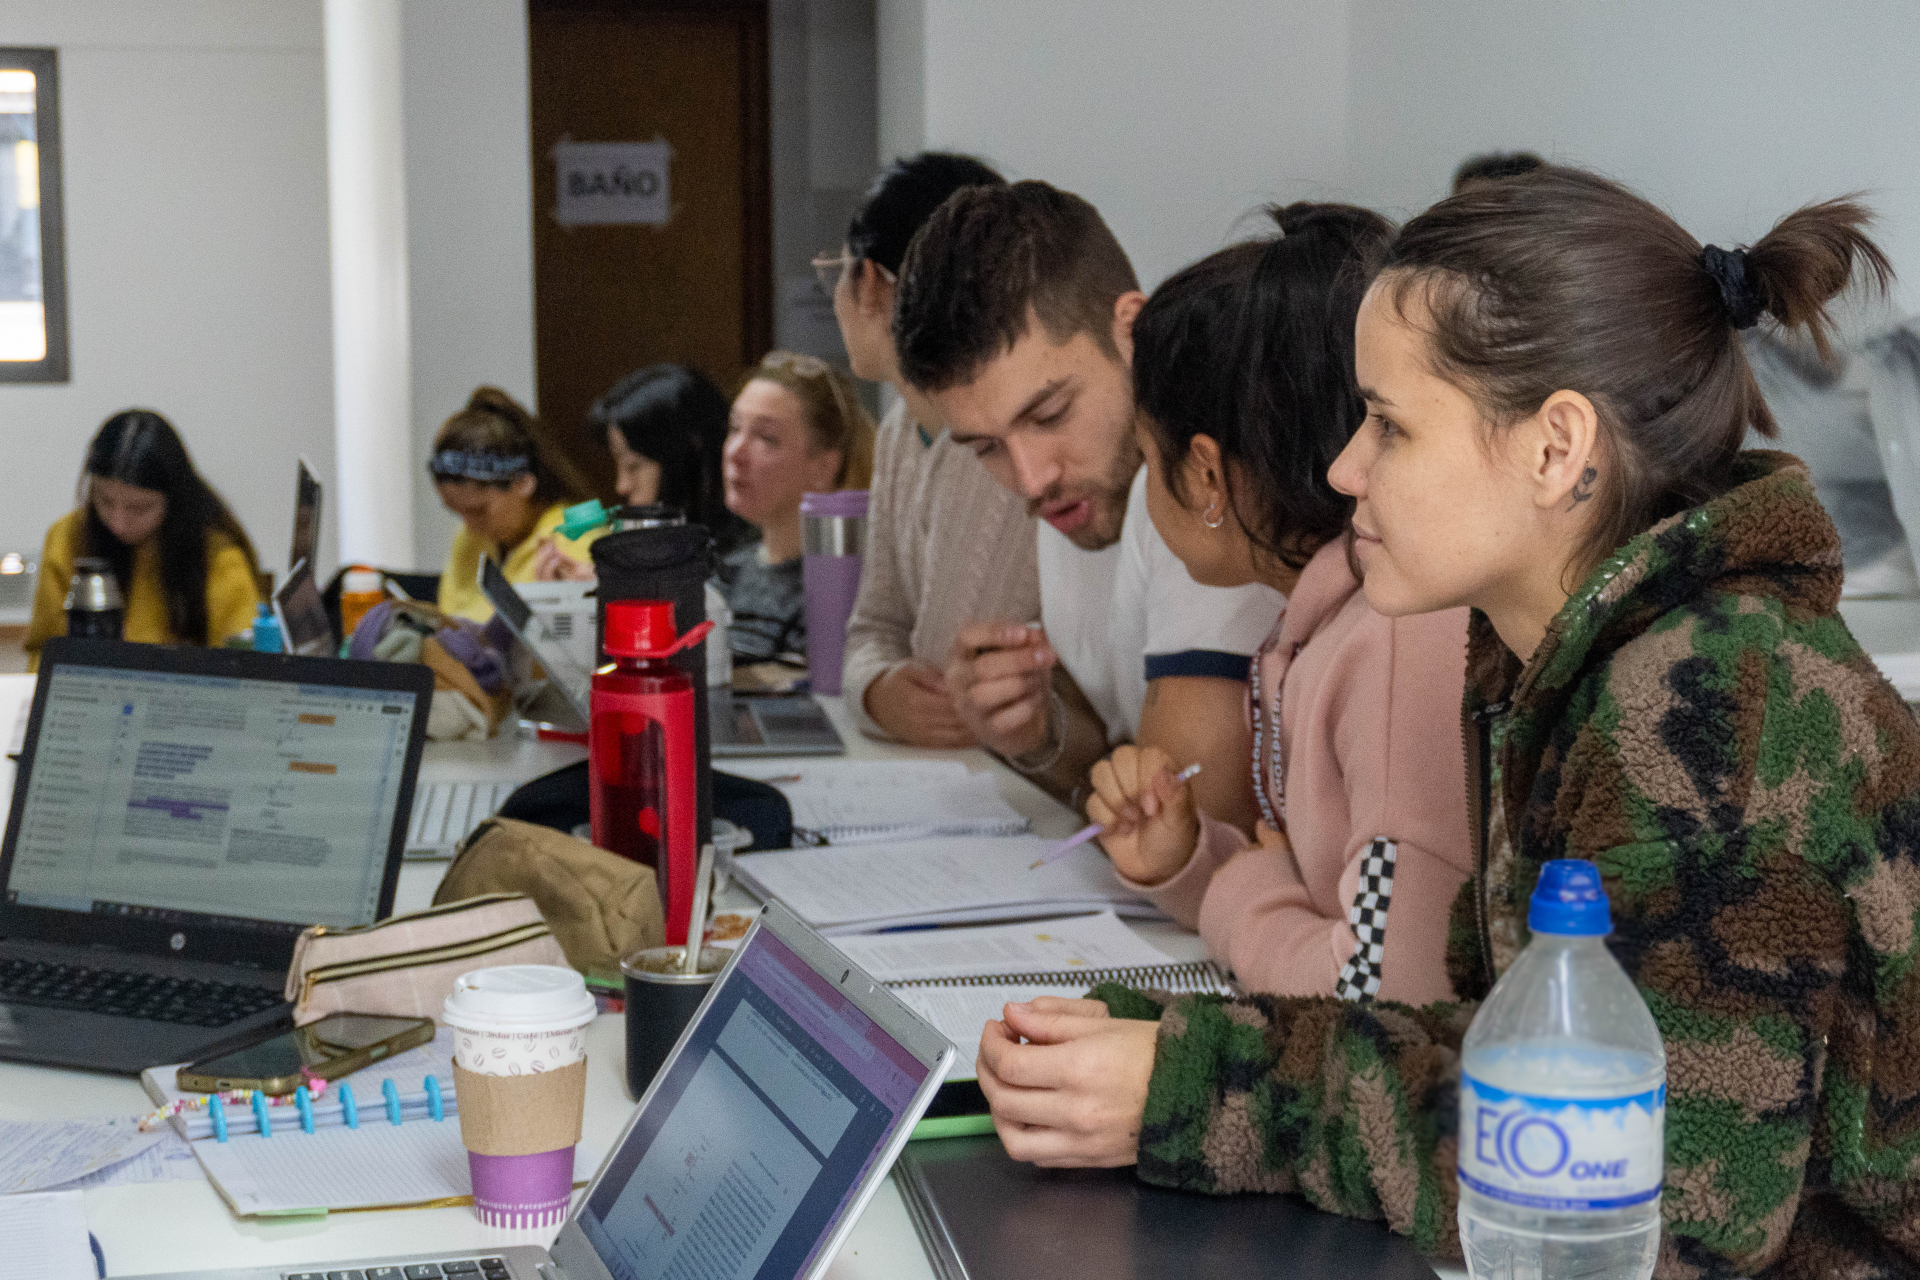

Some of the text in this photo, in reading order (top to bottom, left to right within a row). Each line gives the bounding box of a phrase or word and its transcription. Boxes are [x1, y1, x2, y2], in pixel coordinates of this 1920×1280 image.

[567, 164, 661, 197] BAÑO
[1474, 1105, 1630, 1181] ECO ONE
